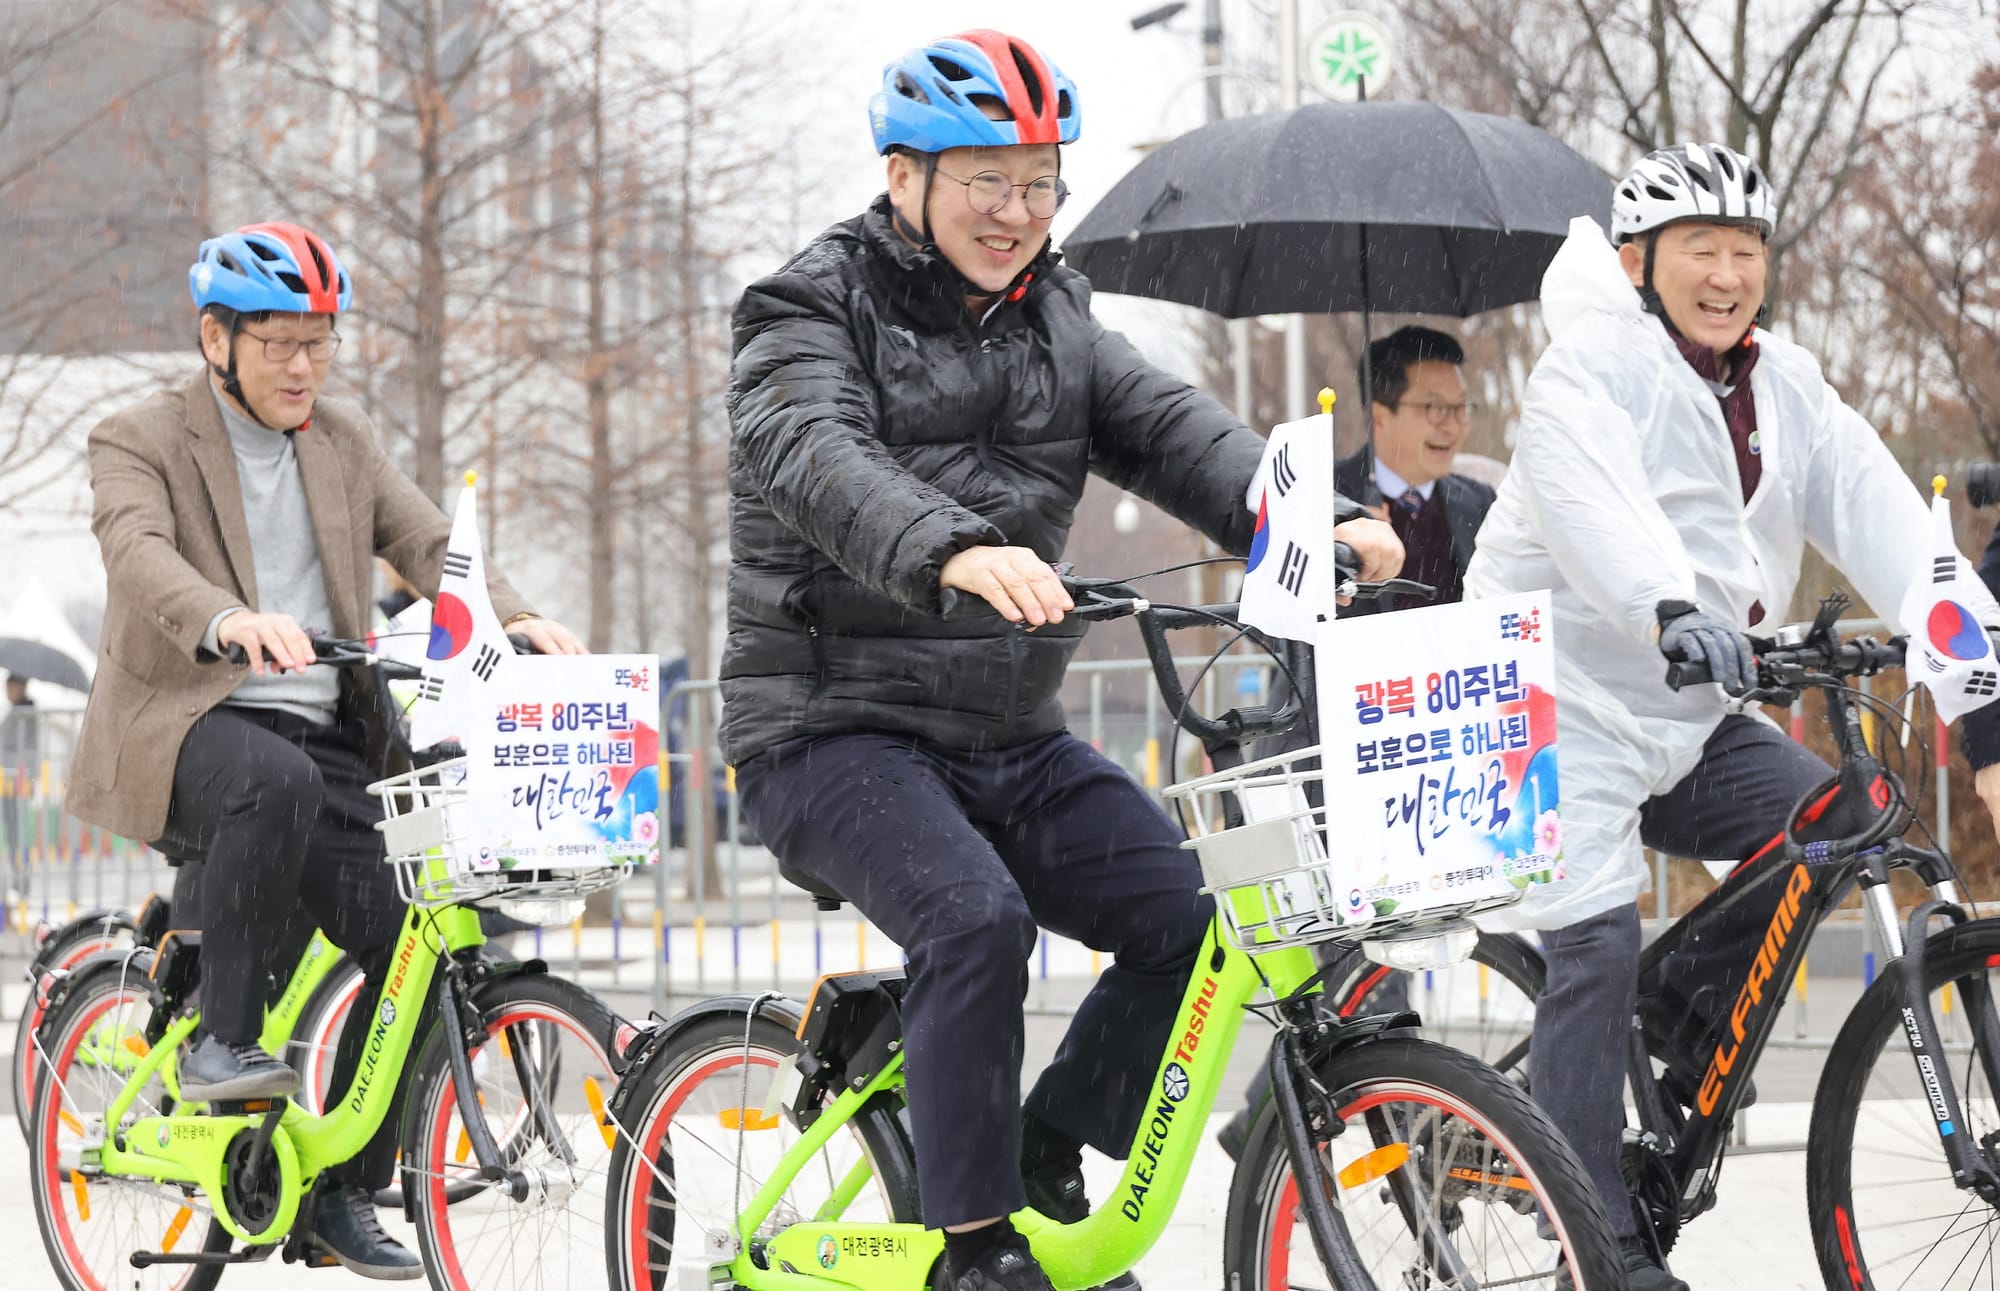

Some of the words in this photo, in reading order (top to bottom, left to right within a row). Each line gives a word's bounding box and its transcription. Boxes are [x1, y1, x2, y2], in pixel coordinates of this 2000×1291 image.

[496, 703, 543, 732] 광복
[552, 702, 634, 732] 80주년,
[1355, 676, 1415, 725] 광복
[1426, 660, 1528, 716] 80주년,
[493, 743, 569, 767] 보훈으로
[577, 742, 633, 765] 하나된
[1356, 728, 1452, 775] 보훈으로
[1461, 714, 1529, 757] 하나된
[512, 770, 614, 831] 대한민국
[1385, 759, 1511, 856] 대한민국
[1697, 863, 1812, 1117] ELFAMA
[352, 1023, 388, 1114] DAEJEON
[388, 936, 416, 998] Tashu
[1122, 1097, 1176, 1223] DAEJEON
[1174, 977, 1218, 1064] Tashu
[843, 1236, 907, 1258] 대전광역시
